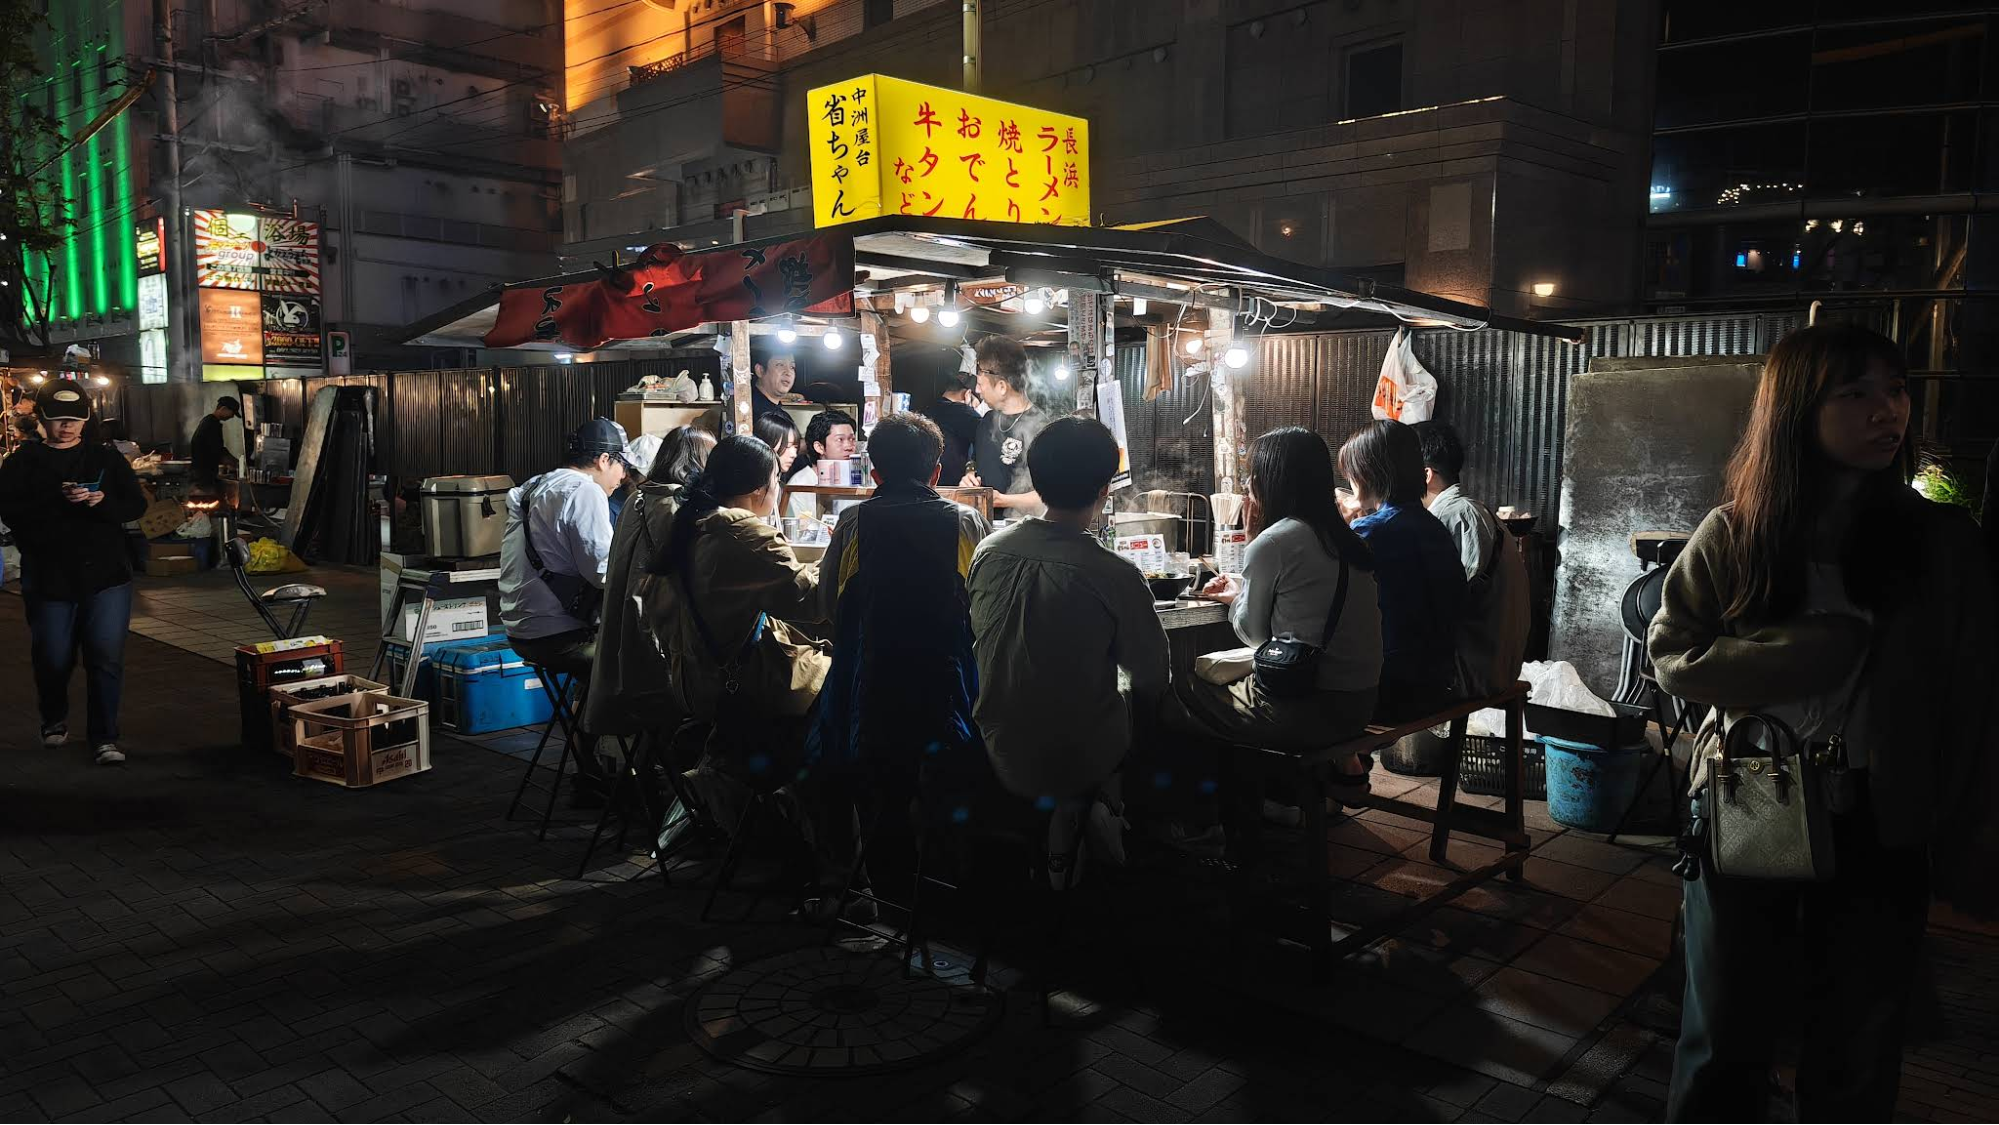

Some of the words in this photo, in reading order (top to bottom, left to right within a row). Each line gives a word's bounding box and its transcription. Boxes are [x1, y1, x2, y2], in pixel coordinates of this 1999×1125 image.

[821, 94, 856, 218] 省ちゃん
[851, 87, 871, 167] 中洲屋台
[913, 101, 944, 217] 牛タン
[1062, 127, 1079, 189] 長浜
[893, 157, 915, 216] など
[957, 108, 987, 220] おでん
[998, 120, 1023, 223] 焼とり
[1037, 126, 1062, 226] ラーメン
[217, 249, 255, 261] group
[331, 335, 346, 357] P
[382, 749, 407, 766] Asahi
[404, 758, 413, 768] 20
